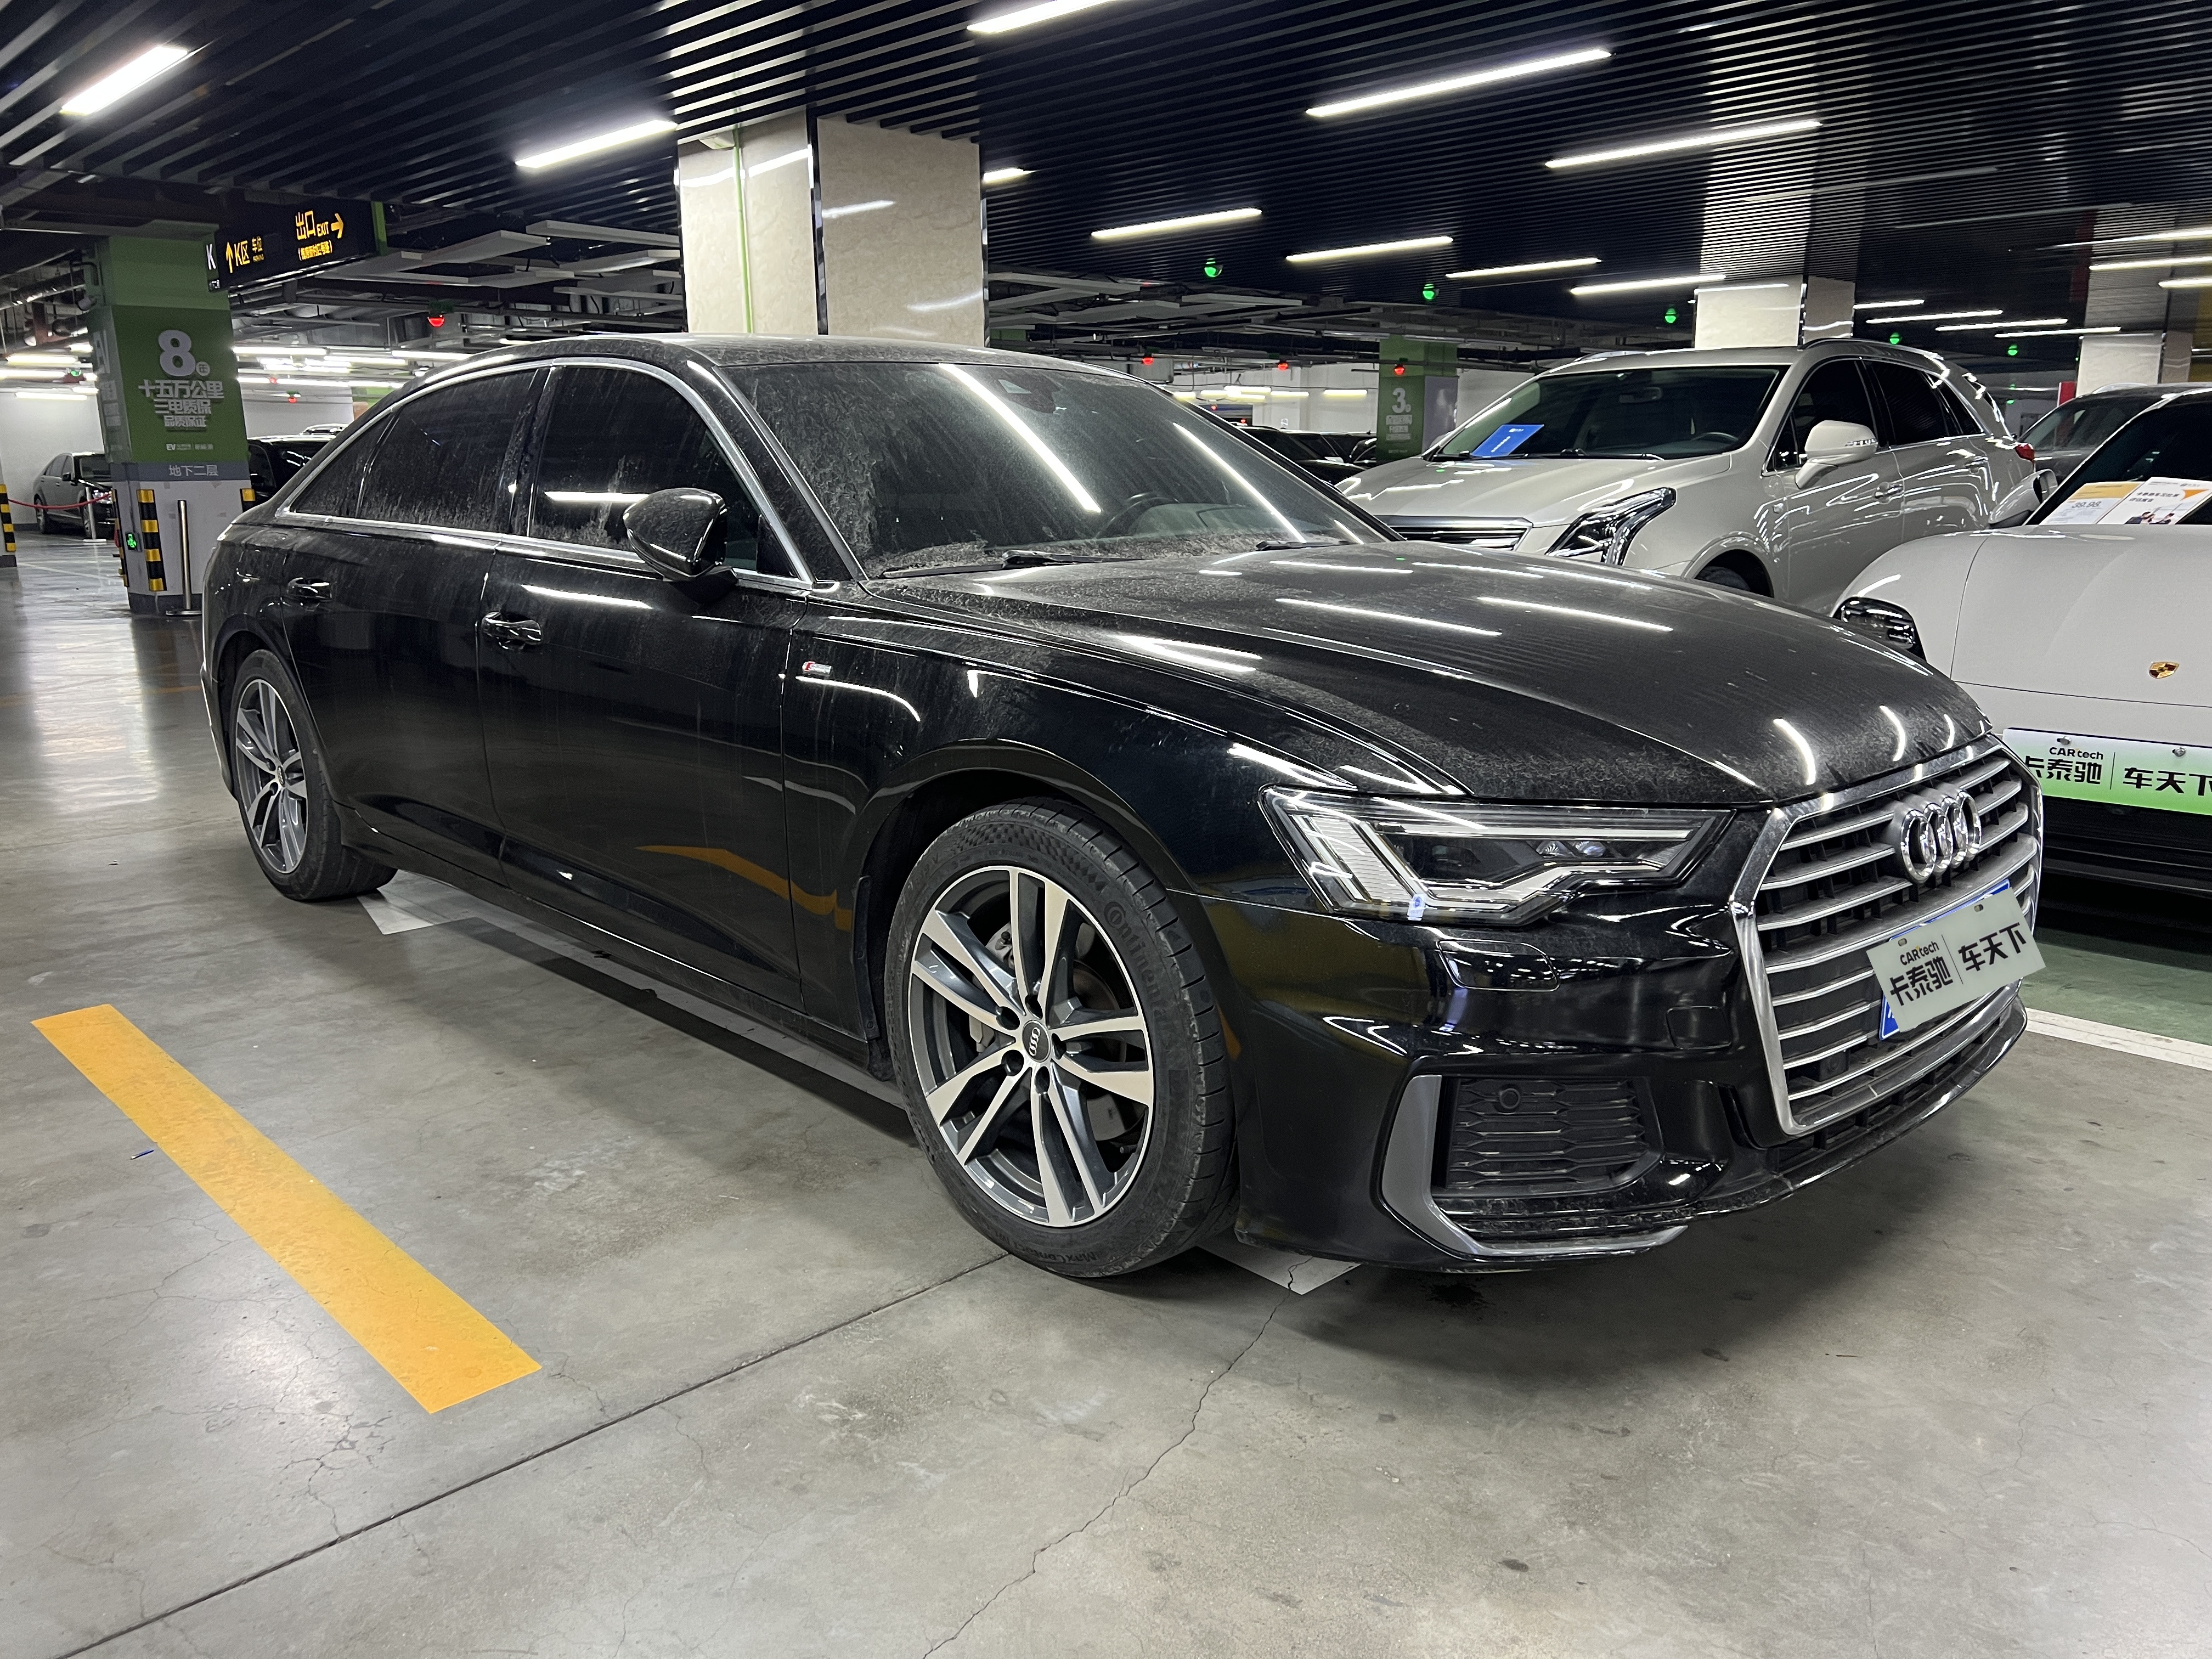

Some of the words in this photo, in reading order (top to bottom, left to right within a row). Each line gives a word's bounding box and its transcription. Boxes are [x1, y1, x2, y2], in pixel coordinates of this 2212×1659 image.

[295, 210, 316, 240] 出口
[317, 221, 329, 237] EXIT
[234, 240, 251, 267] K区
[138, 379, 224, 399] 十五万公里
[154, 399, 212, 415] 三电质保
[164, 415, 206, 427] 品质保证
[169, 464, 218, 477] 地下二层
[2049, 747, 2104, 760] CARtech
[2123, 767, 2212, 796] 车天下
